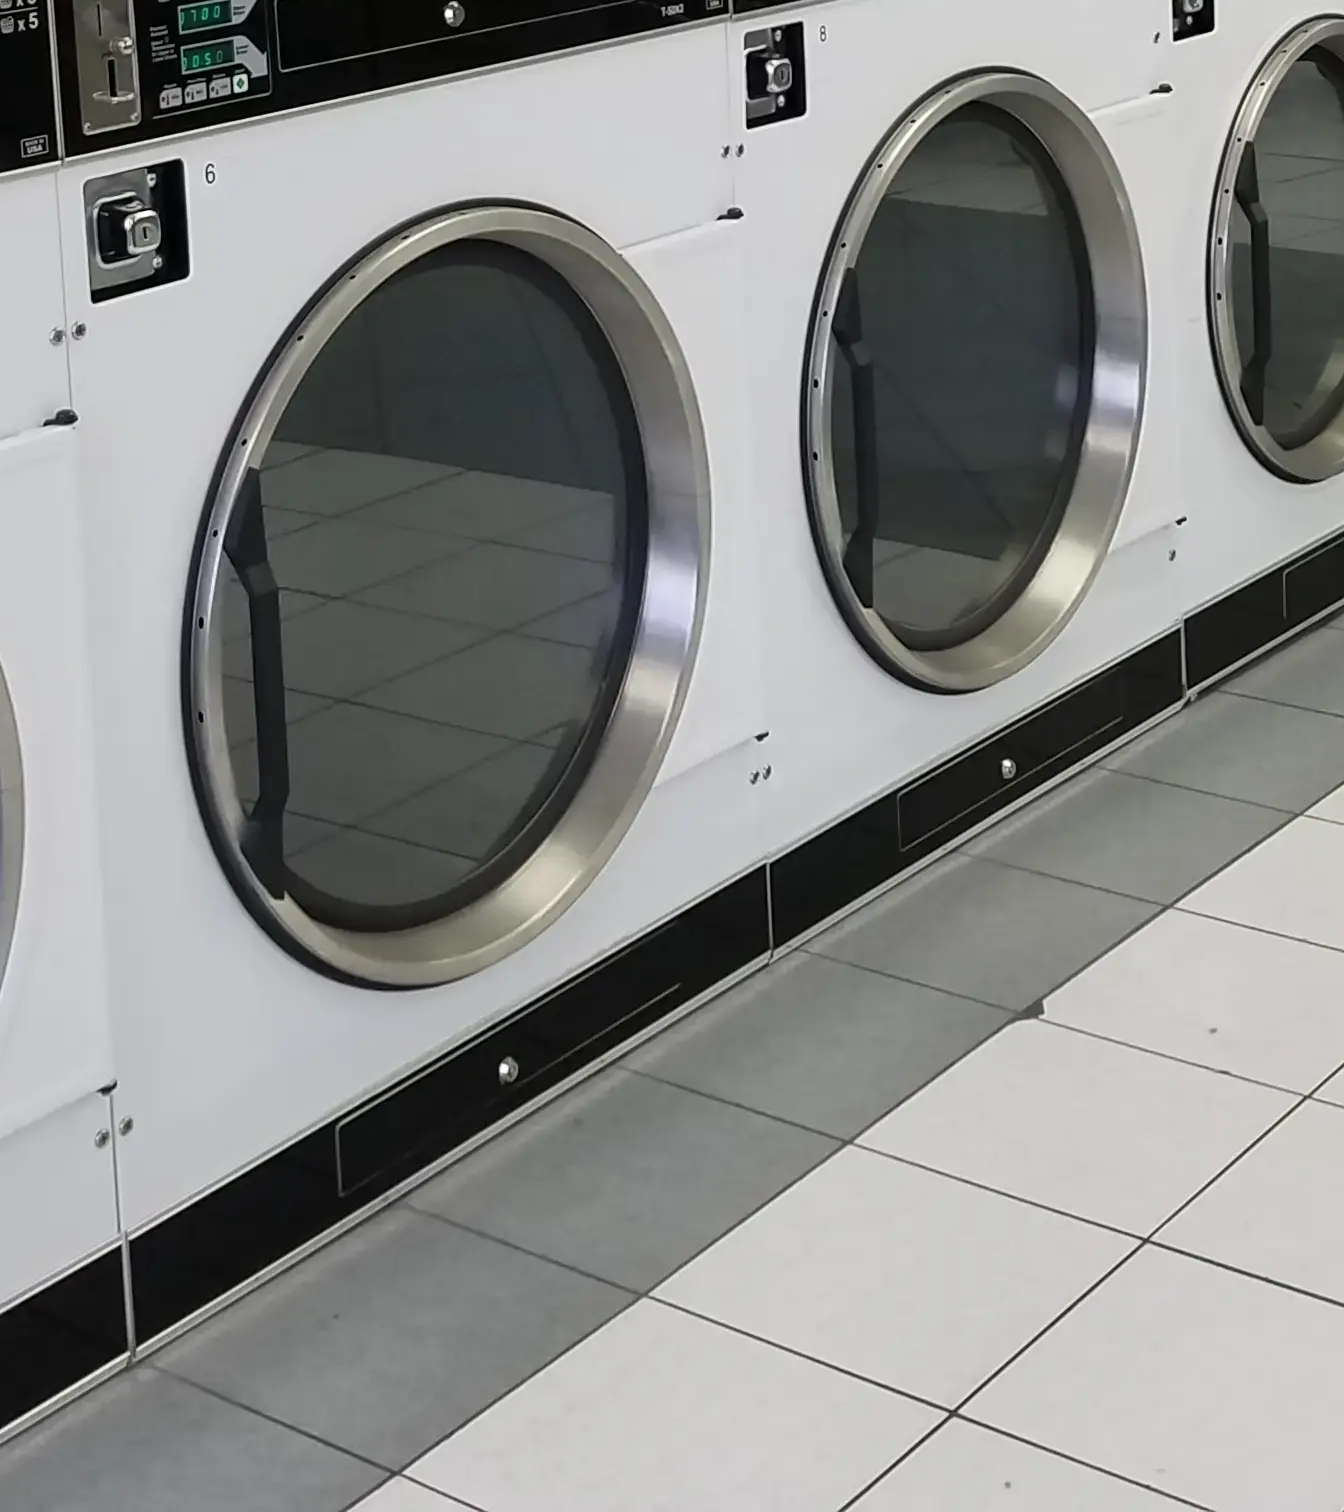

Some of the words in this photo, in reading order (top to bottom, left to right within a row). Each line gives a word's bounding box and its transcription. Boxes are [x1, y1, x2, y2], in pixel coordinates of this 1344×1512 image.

[17, 20, 26, 32] x
[28, 12, 39, 29] 5
[820, 25, 827, 42] 8
[206, 163, 216, 184] 6
